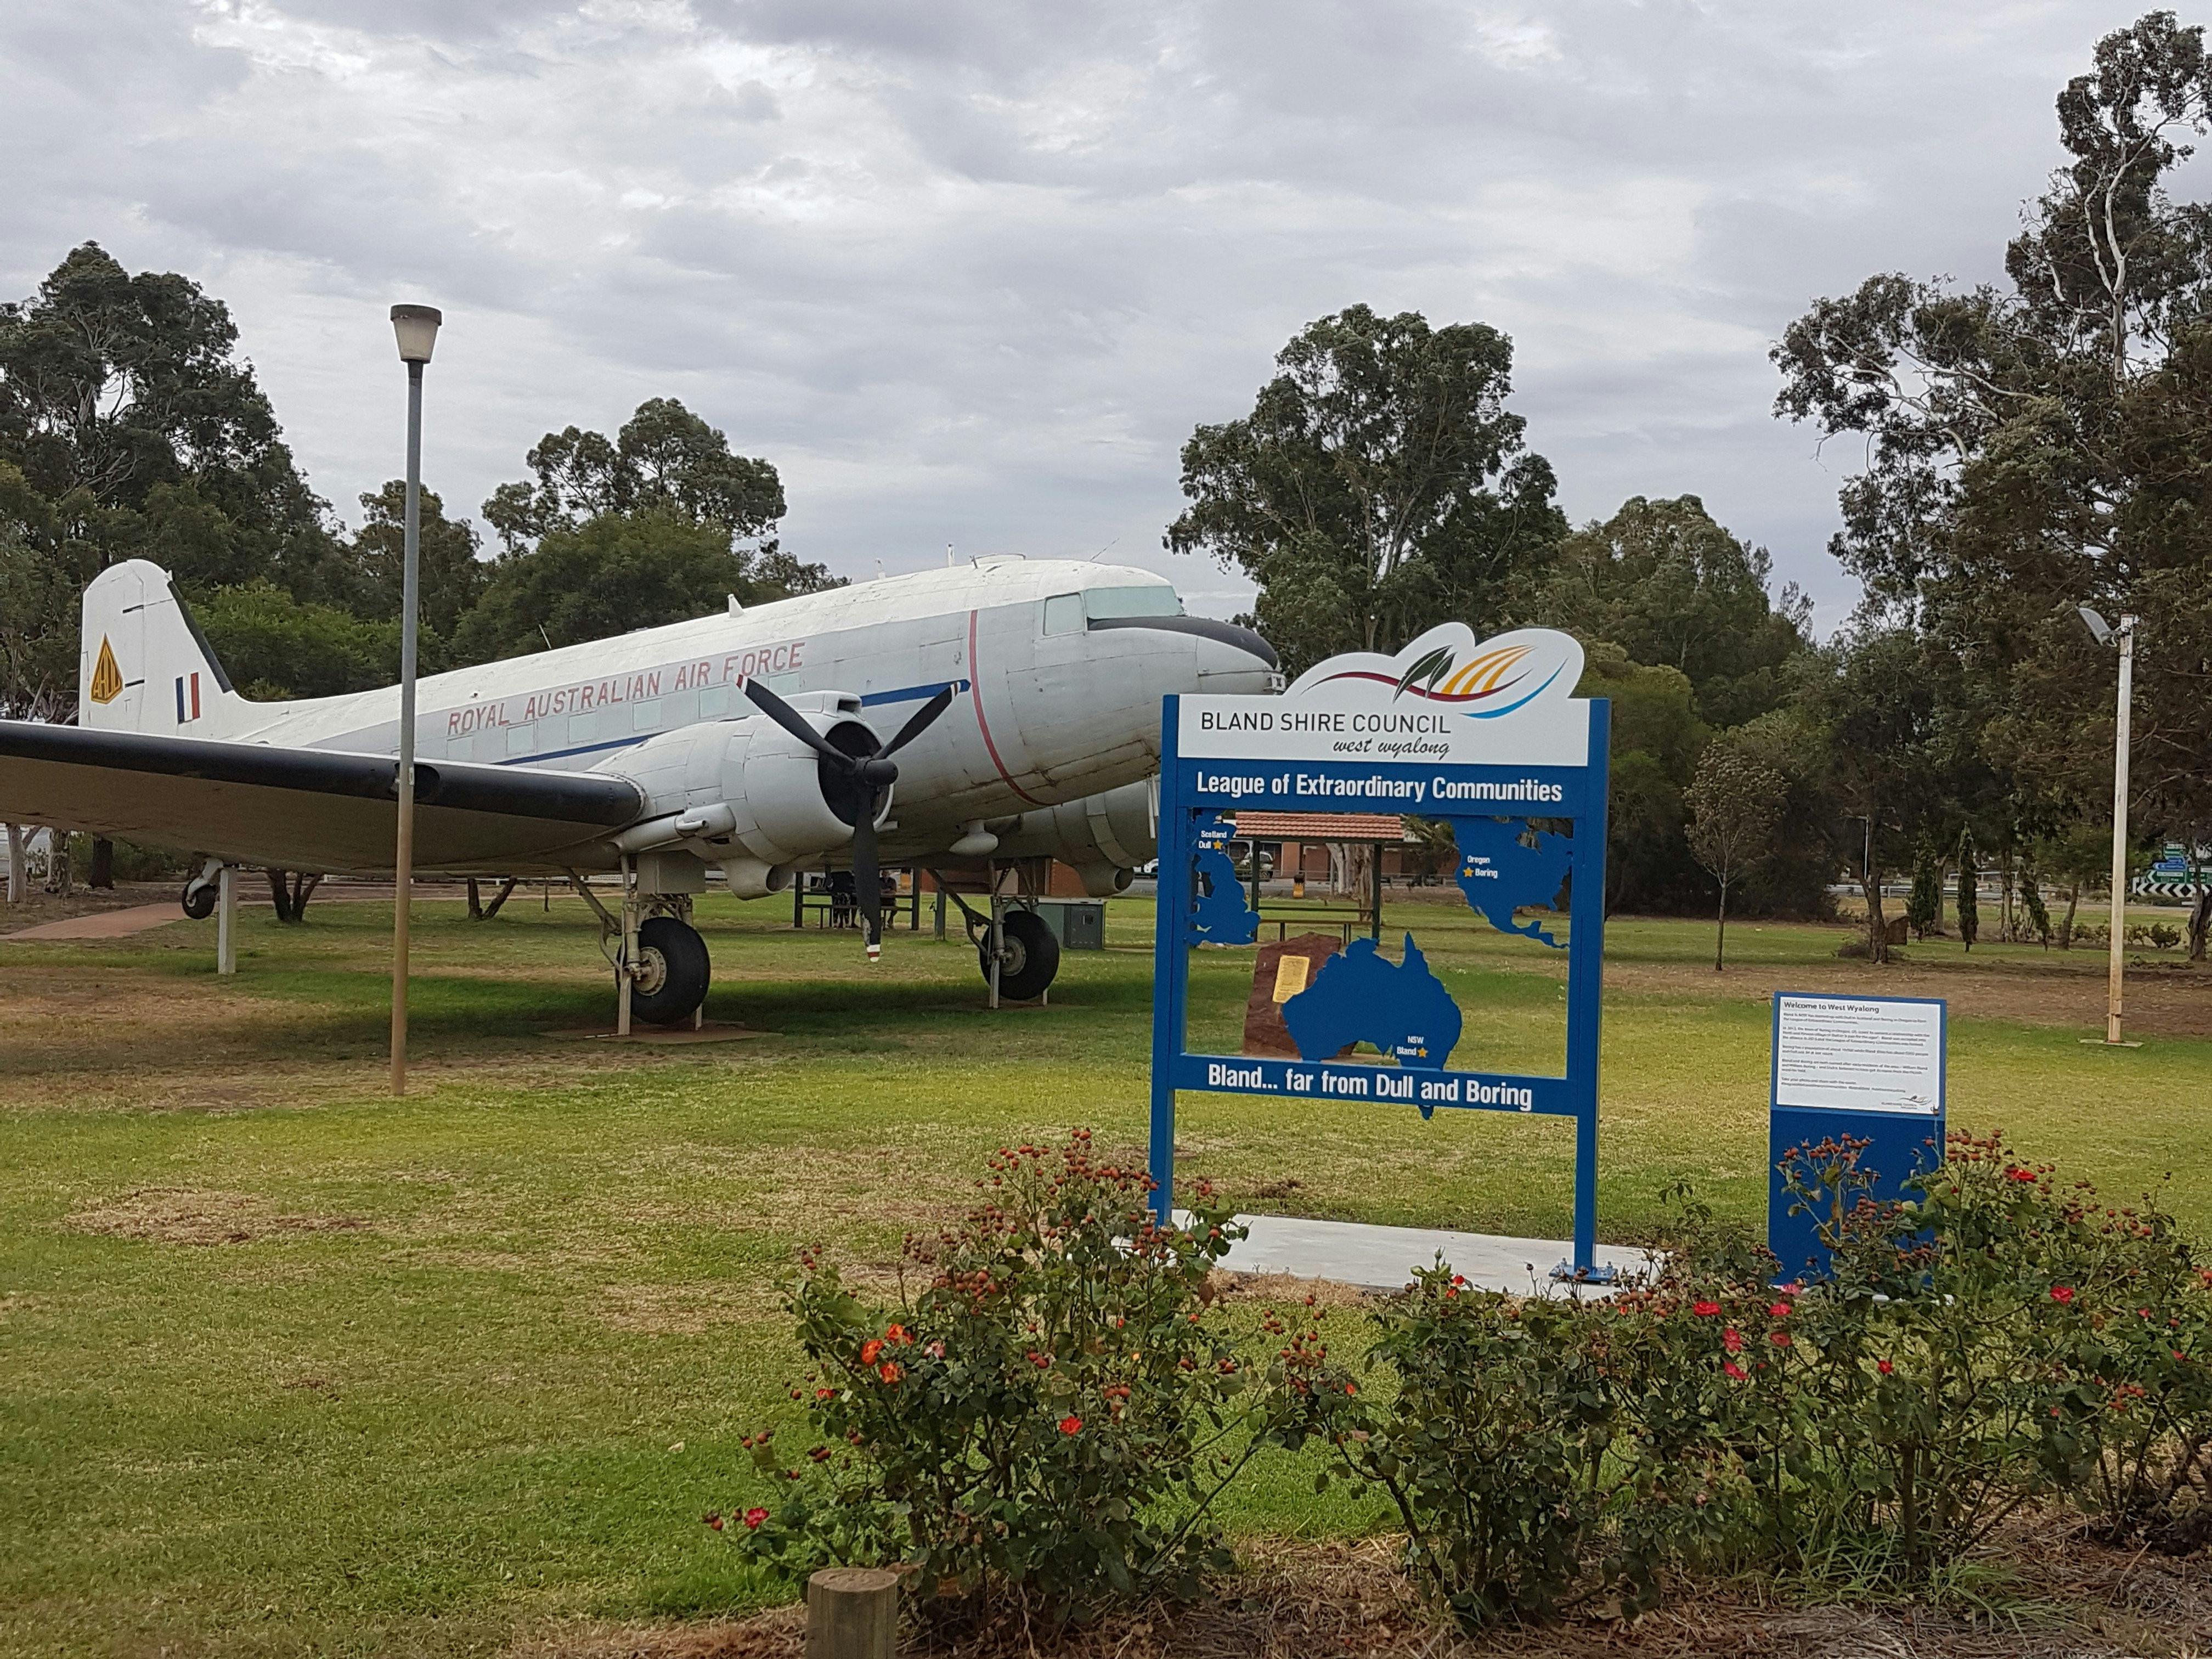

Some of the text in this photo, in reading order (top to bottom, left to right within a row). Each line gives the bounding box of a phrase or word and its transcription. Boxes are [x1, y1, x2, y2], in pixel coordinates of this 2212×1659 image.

[448, 642, 805, 735] ROYAL AUSTRALIAN AIR FORCE
[1201, 712, 1451, 734] BLAND SHIRE COUNCIL
[1333, 737, 1451, 760] west wyalong
[1197, 771, 1562, 802] League of Extraordinary Communities
[1201, 830, 1227, 838] Scotland
[1198, 840, 1211, 849] Dull
[1467, 855, 1490, 865] Oregon
[1475, 868, 1498, 879] Boring
[1784, 1001, 1817, 1009] Welcome
[1847, 1005, 1879, 1014] Wyalong
[1407, 1035, 1424, 1043] NSW
[1396, 1046, 1417, 1056] Bland
[1208, 1064, 1532, 1111] Bland... far from Dull and Boring
